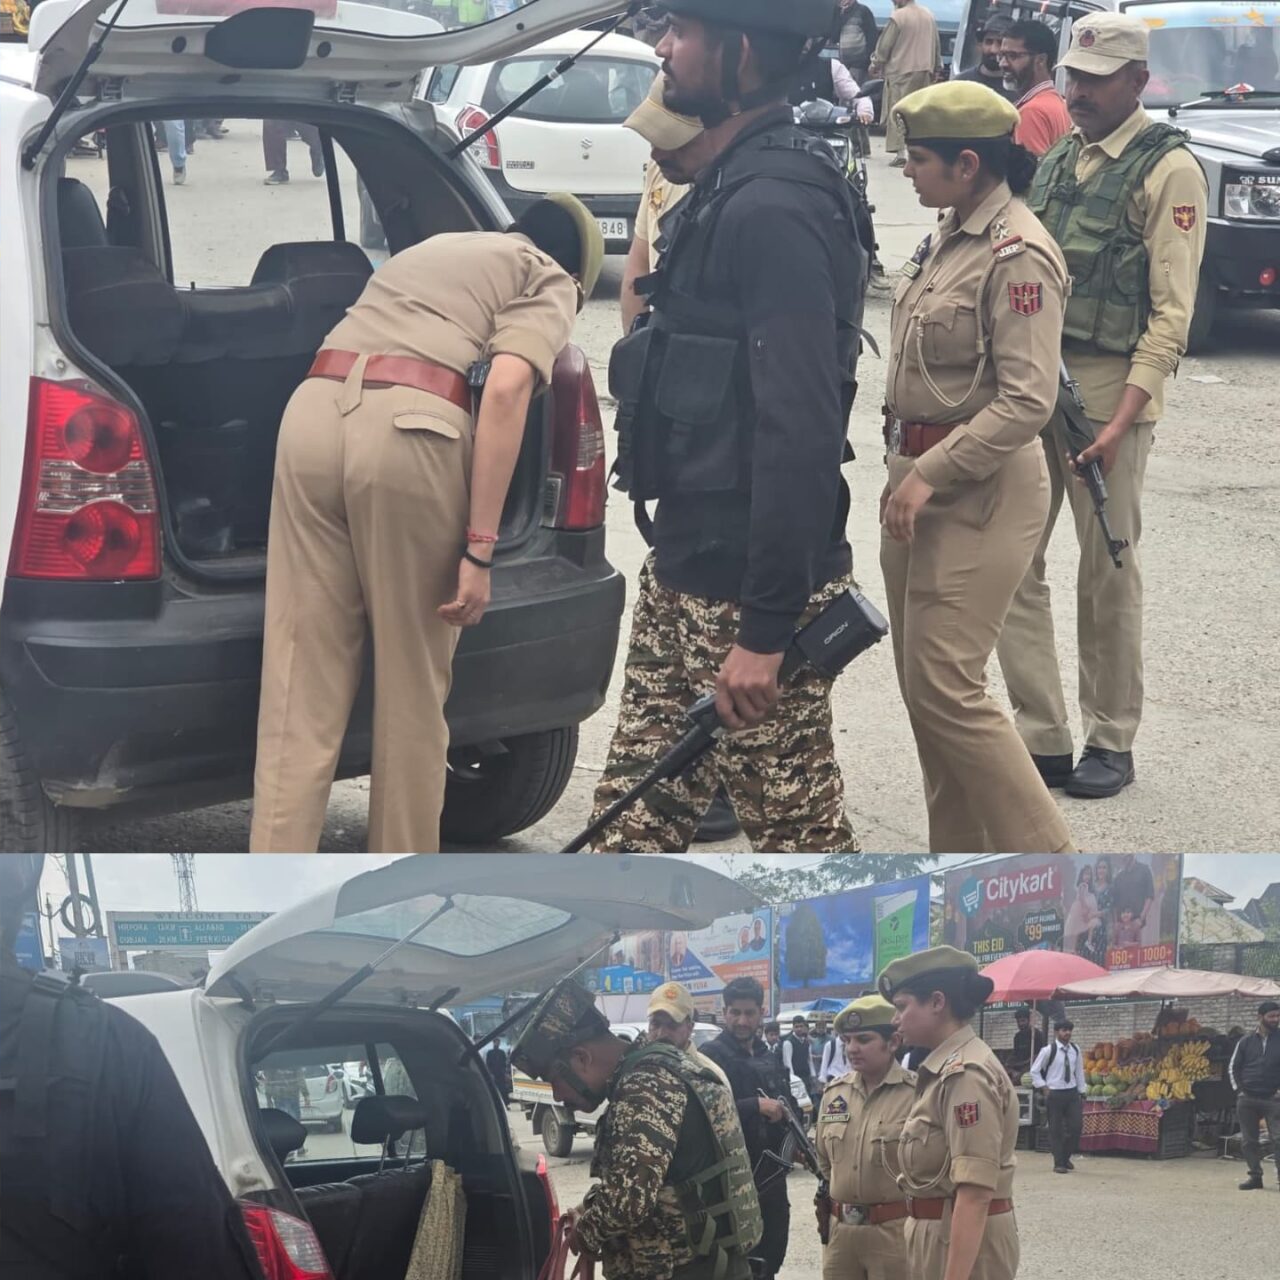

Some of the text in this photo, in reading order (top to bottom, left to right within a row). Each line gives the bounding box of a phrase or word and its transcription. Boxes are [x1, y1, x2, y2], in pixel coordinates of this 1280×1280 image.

[986, 870, 1054, 904] Citykart
[155, 912, 224, 920] WELCOME
[974, 937, 1004, 953] THIS EID
